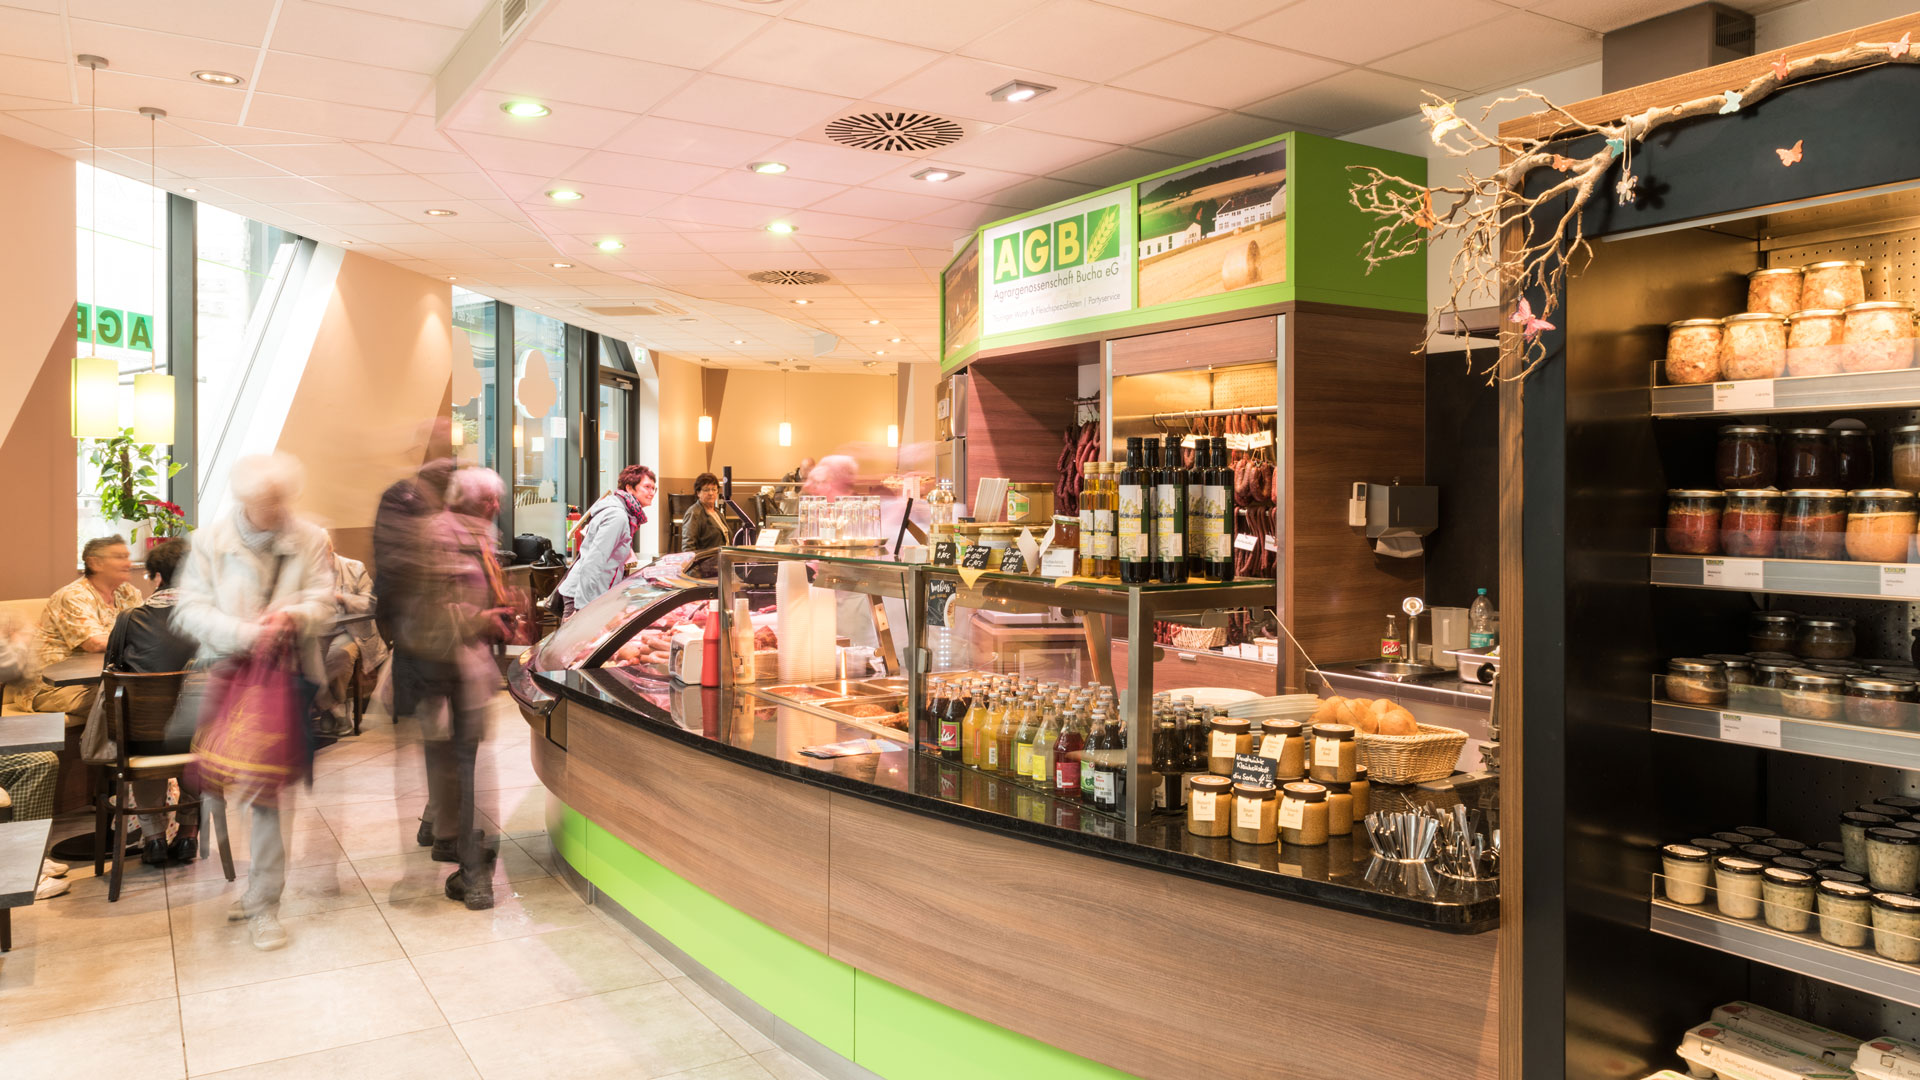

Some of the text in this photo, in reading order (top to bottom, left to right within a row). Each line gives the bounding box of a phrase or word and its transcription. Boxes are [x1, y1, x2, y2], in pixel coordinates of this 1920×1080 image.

[995, 221, 1080, 281] AGB
[993, 261, 1119, 302] Agrargenossenschaft Bucha eG
[1088, 293, 1121, 305] Partyservice
[1383, 644, 1400, 654] Cola
